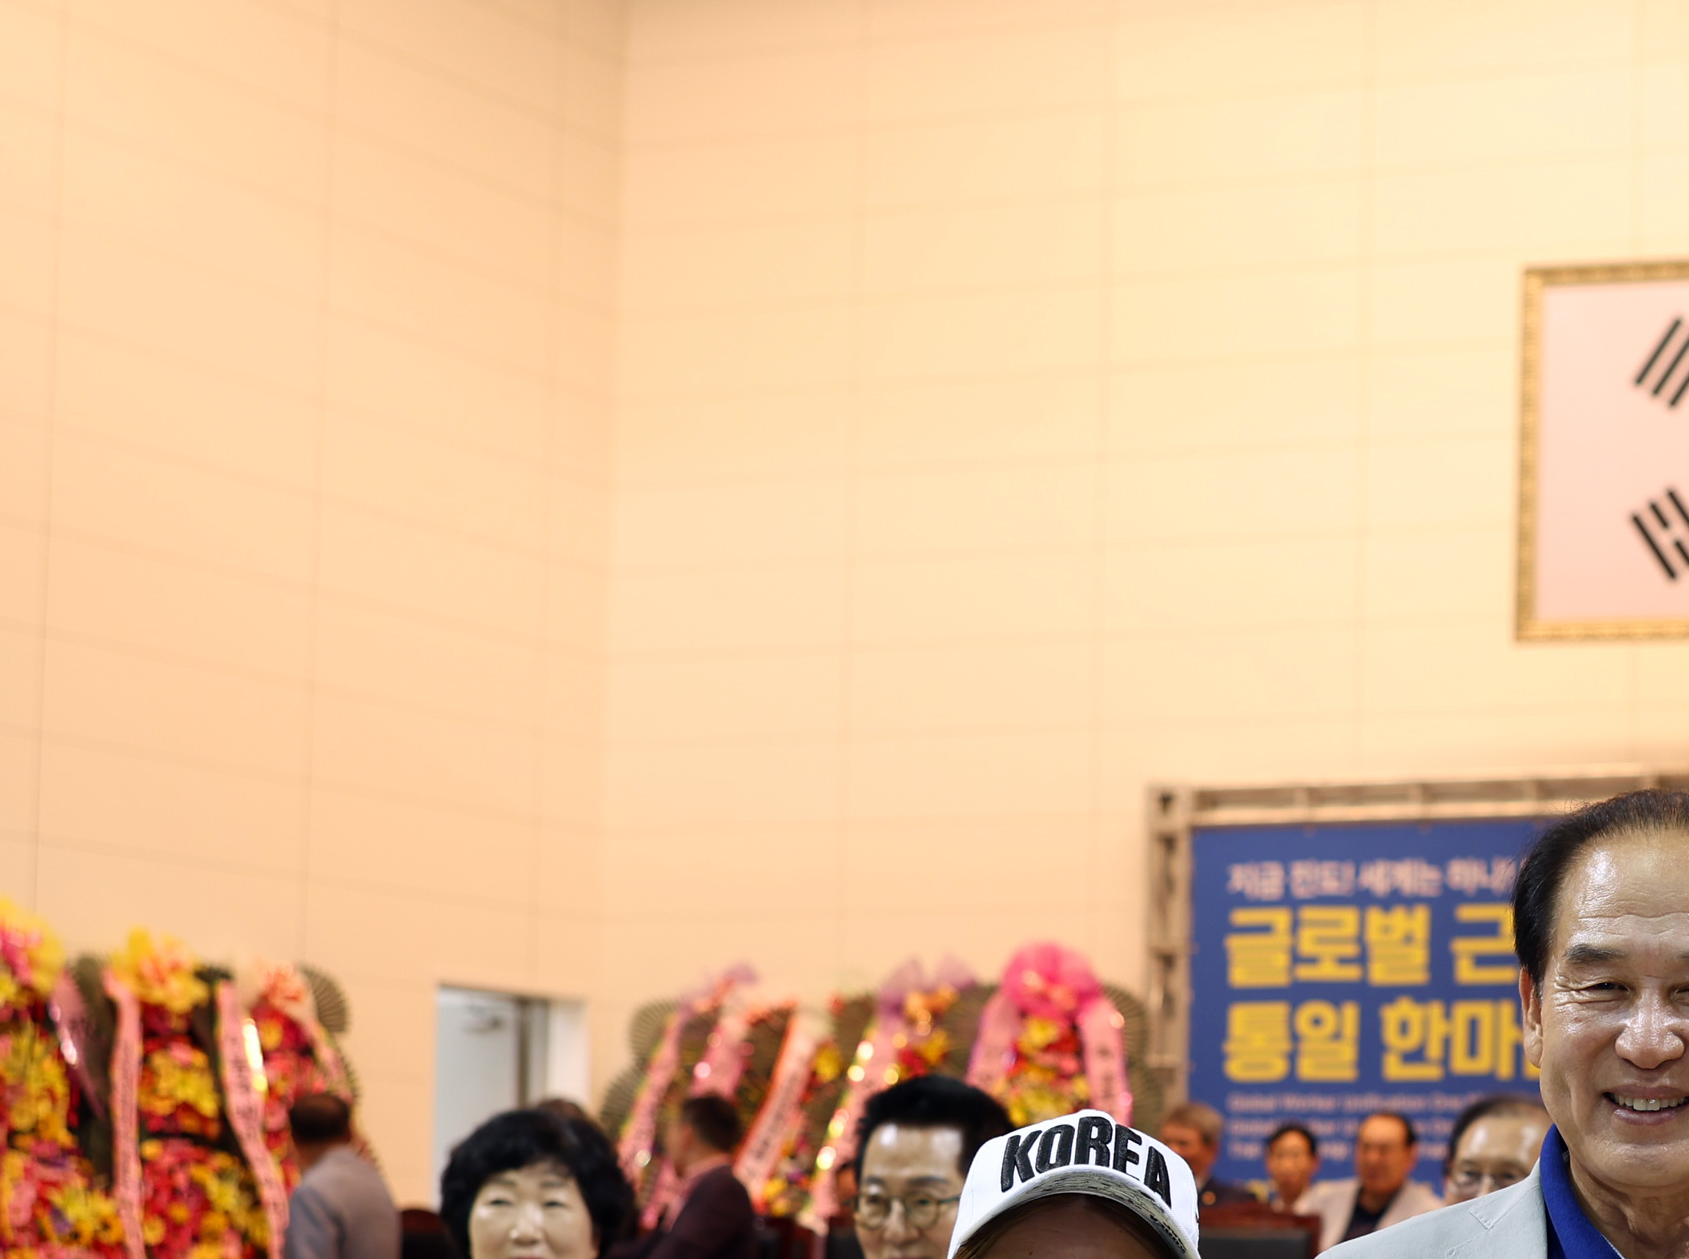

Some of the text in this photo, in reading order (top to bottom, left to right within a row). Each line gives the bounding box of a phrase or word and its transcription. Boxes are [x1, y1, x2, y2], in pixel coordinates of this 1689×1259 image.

[1225, 903, 1431, 988] 글로벌
[1223, 996, 1541, 1082] 통일 한마
[1000, 1116, 1171, 1208] KOREA
